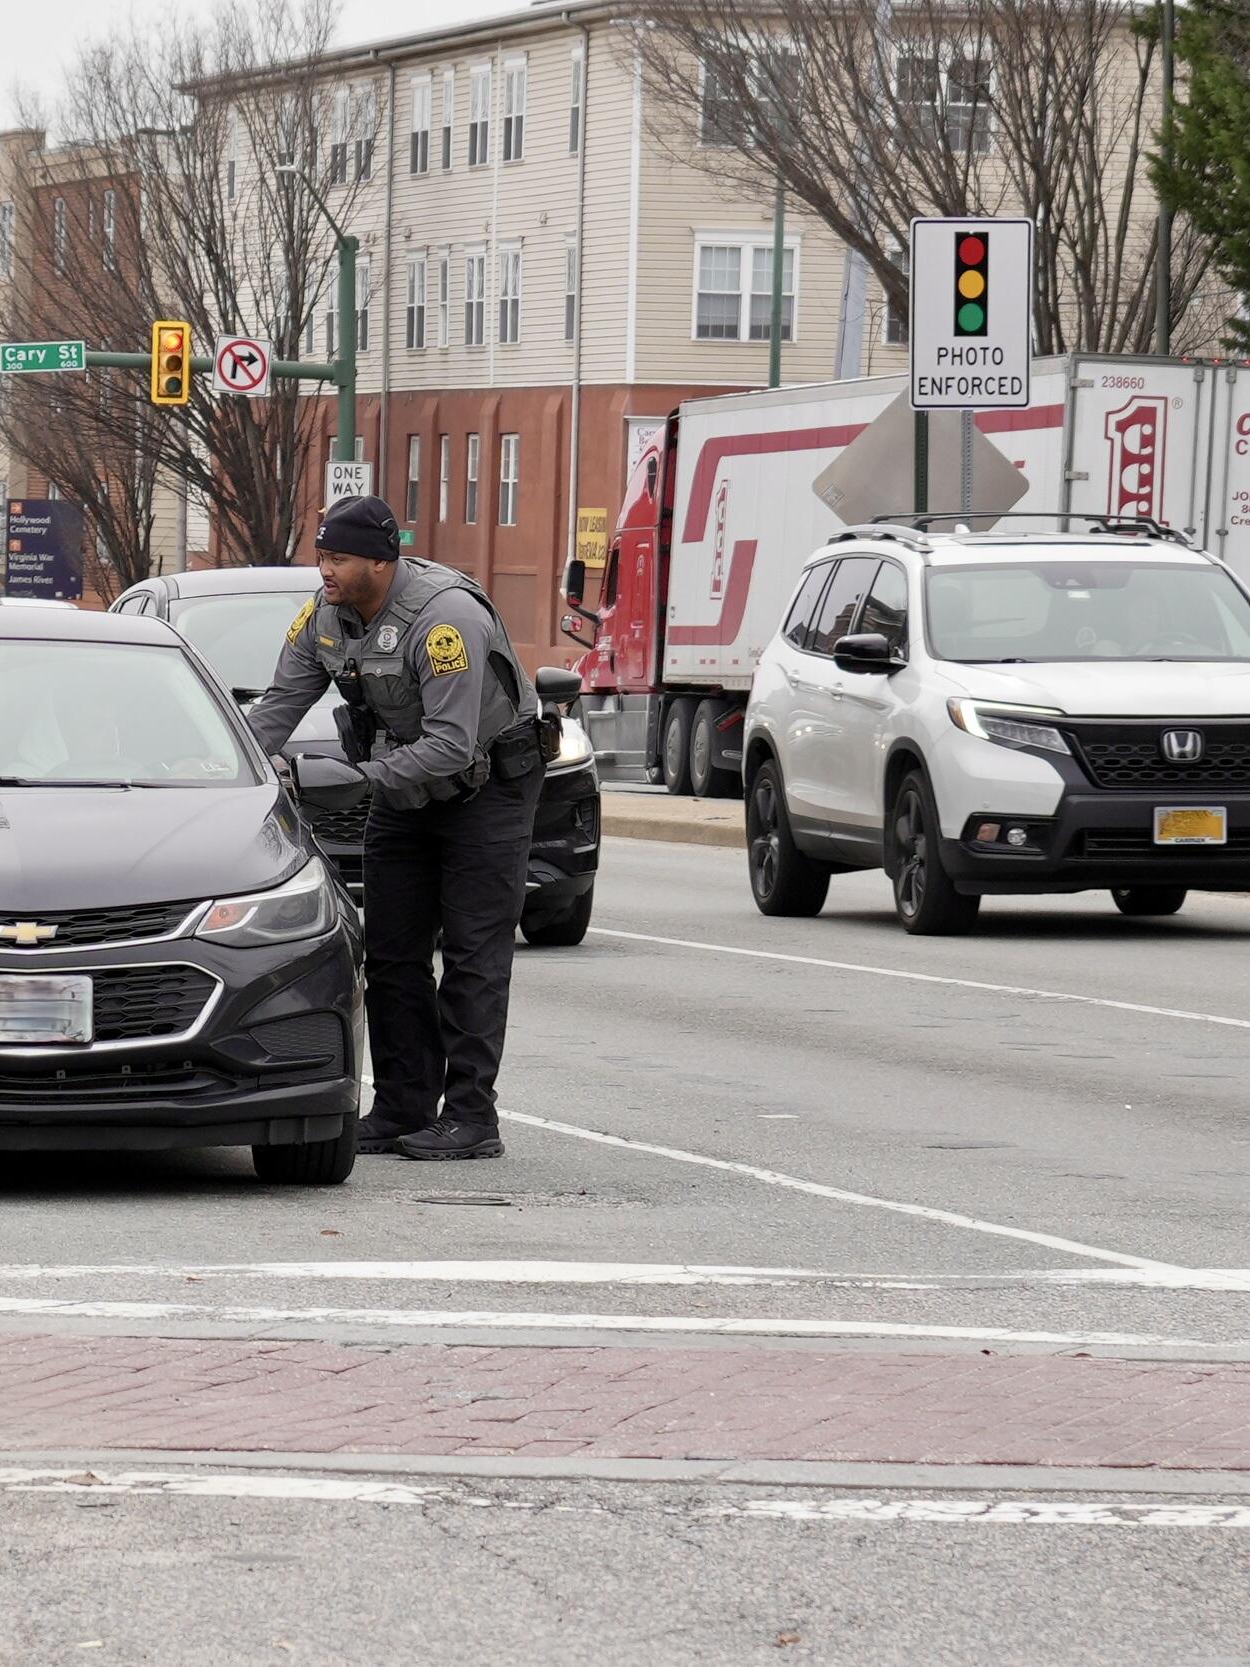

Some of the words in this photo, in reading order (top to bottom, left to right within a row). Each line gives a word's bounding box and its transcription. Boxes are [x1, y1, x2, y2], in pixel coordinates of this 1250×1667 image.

[5, 347, 47, 364] Cary
[58, 345, 78, 360] St
[937, 347, 1004, 366] PHOTO
[5, 362, 23, 370] 300
[60, 360, 78, 368] 600
[918, 376, 1022, 396] ENFORCED
[1101, 376, 1145, 389] 238660
[333, 466, 363, 480] ONE
[332, 483, 364, 495] WAY
[10, 516, 51, 526] Hollywood
[10, 526, 47, 535] Cemetery
[9, 554, 37, 562] Virginia
[9, 563, 44, 571] Memorial
[9, 576, 32, 584] James
[435, 659, 466, 673] POLICE
